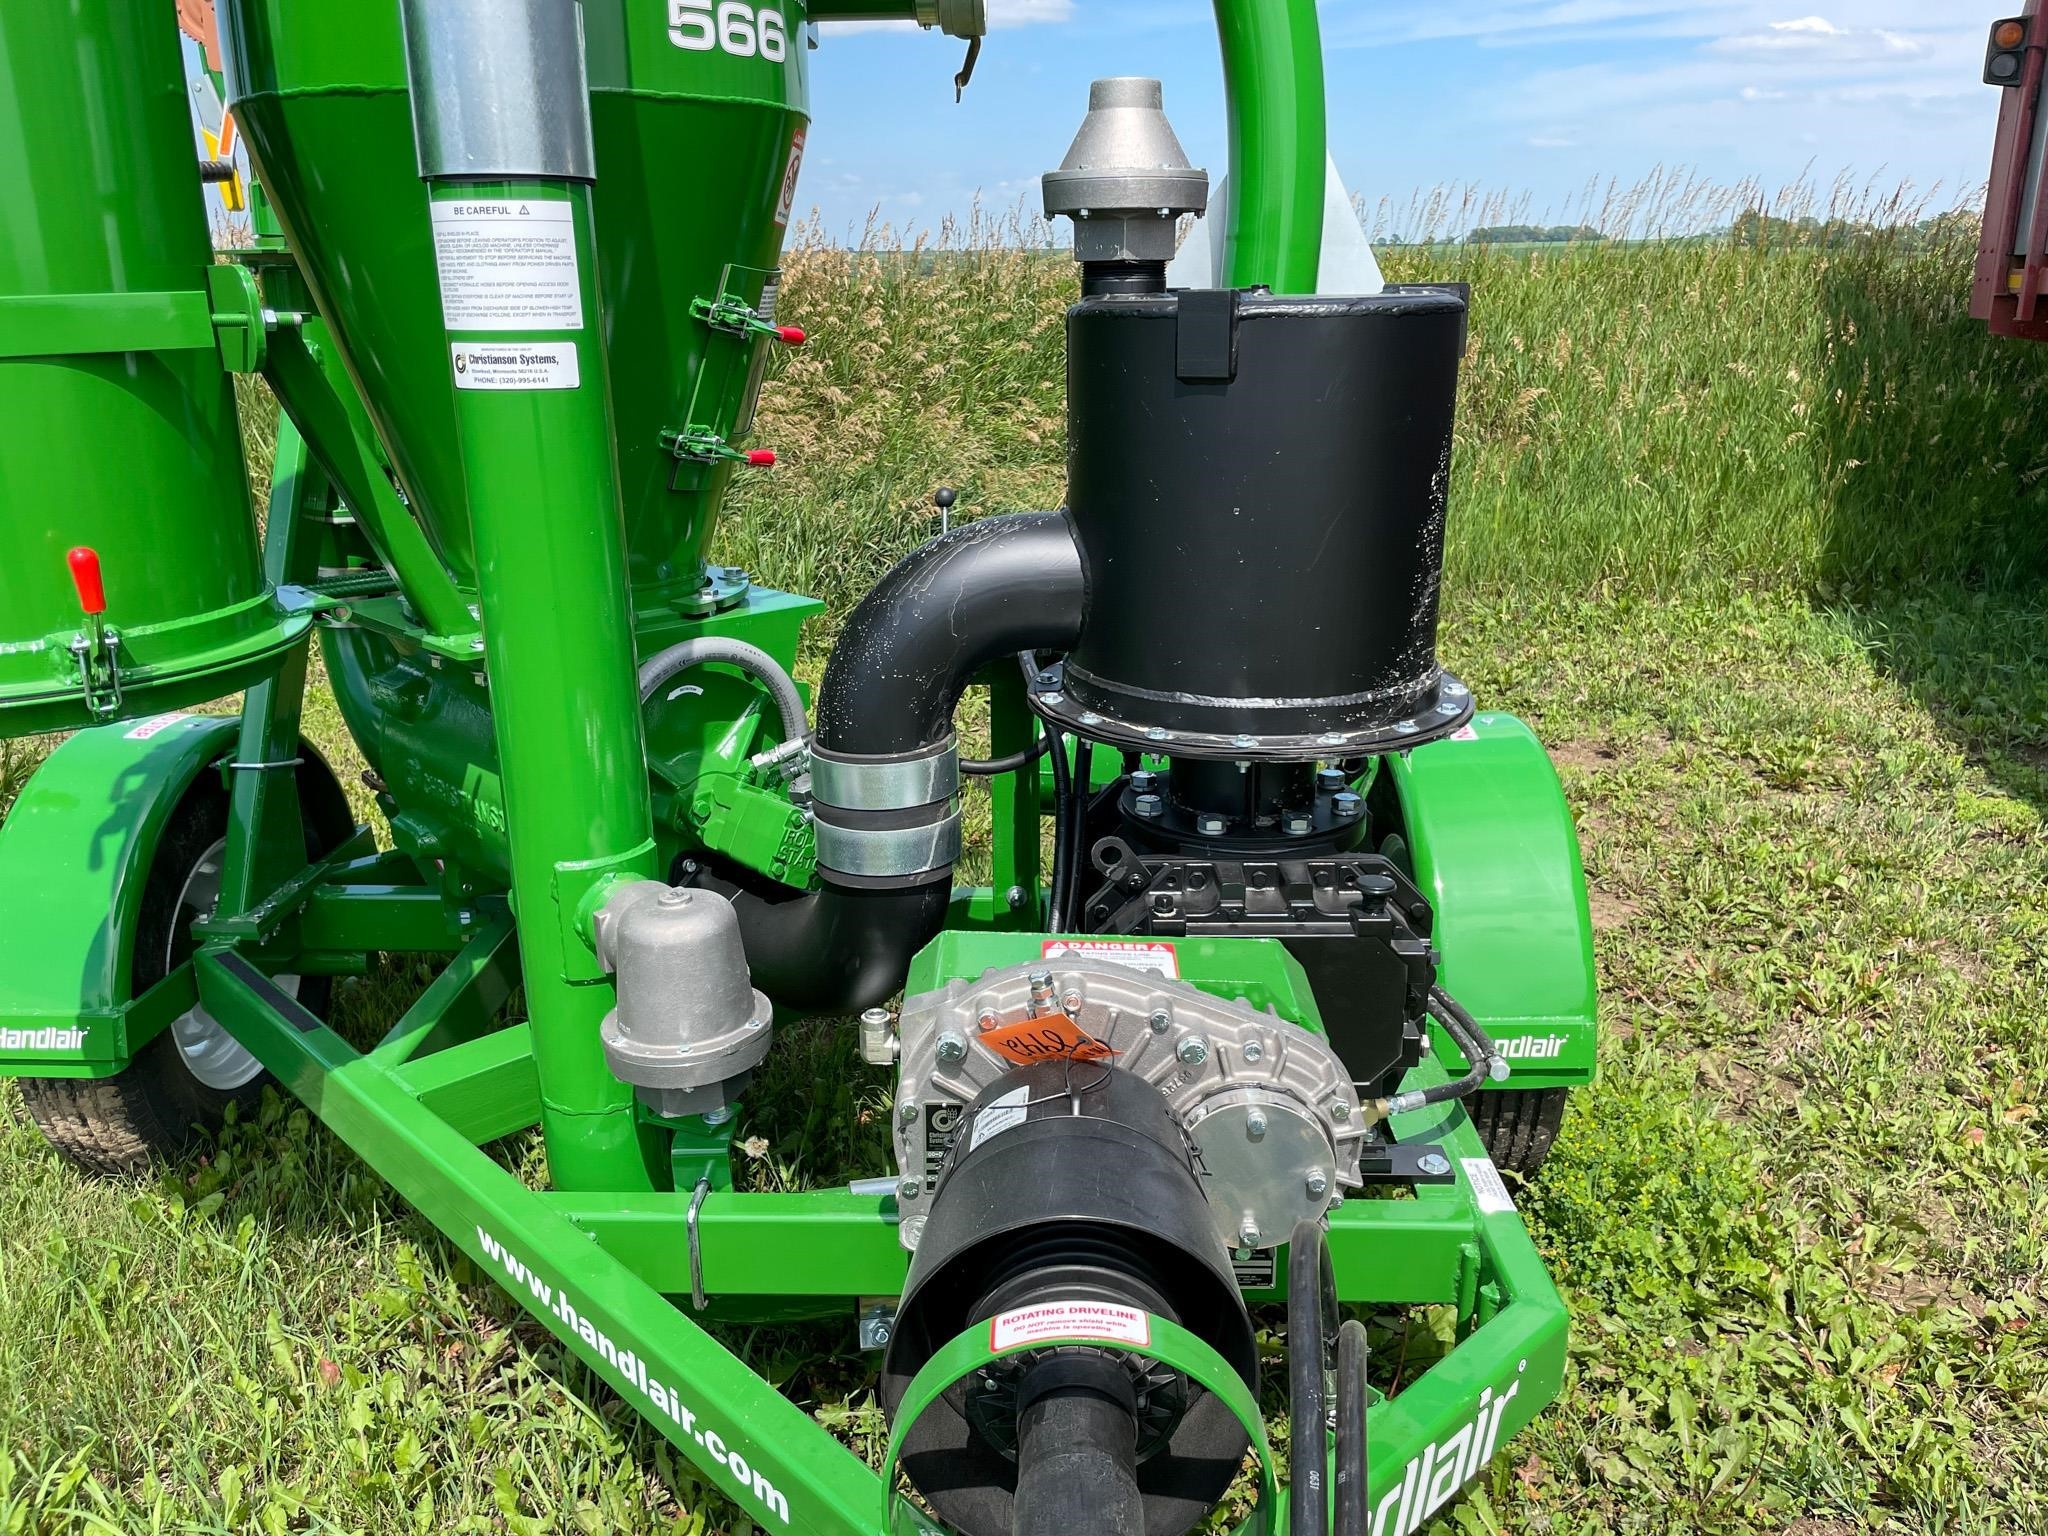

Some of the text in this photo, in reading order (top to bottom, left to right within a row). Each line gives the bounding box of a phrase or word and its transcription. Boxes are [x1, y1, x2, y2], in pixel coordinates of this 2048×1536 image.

[668, 0, 786, 63] 566
[453, 206, 511, 215] BE CAREFUL
[468, 353, 559, 366] Christianson Systems,
[499, 376, 549, 385] (320)-995-6141
[1068, 942, 1149, 951] DANGER
[1002, 1306, 1138, 1327] ROTATING DRIVELINE
[1027, 1321, 1046, 1329] NOT
[1027, 1326, 1061, 1334] machine
[476, 1225, 790, 1525] www.handlair.com
